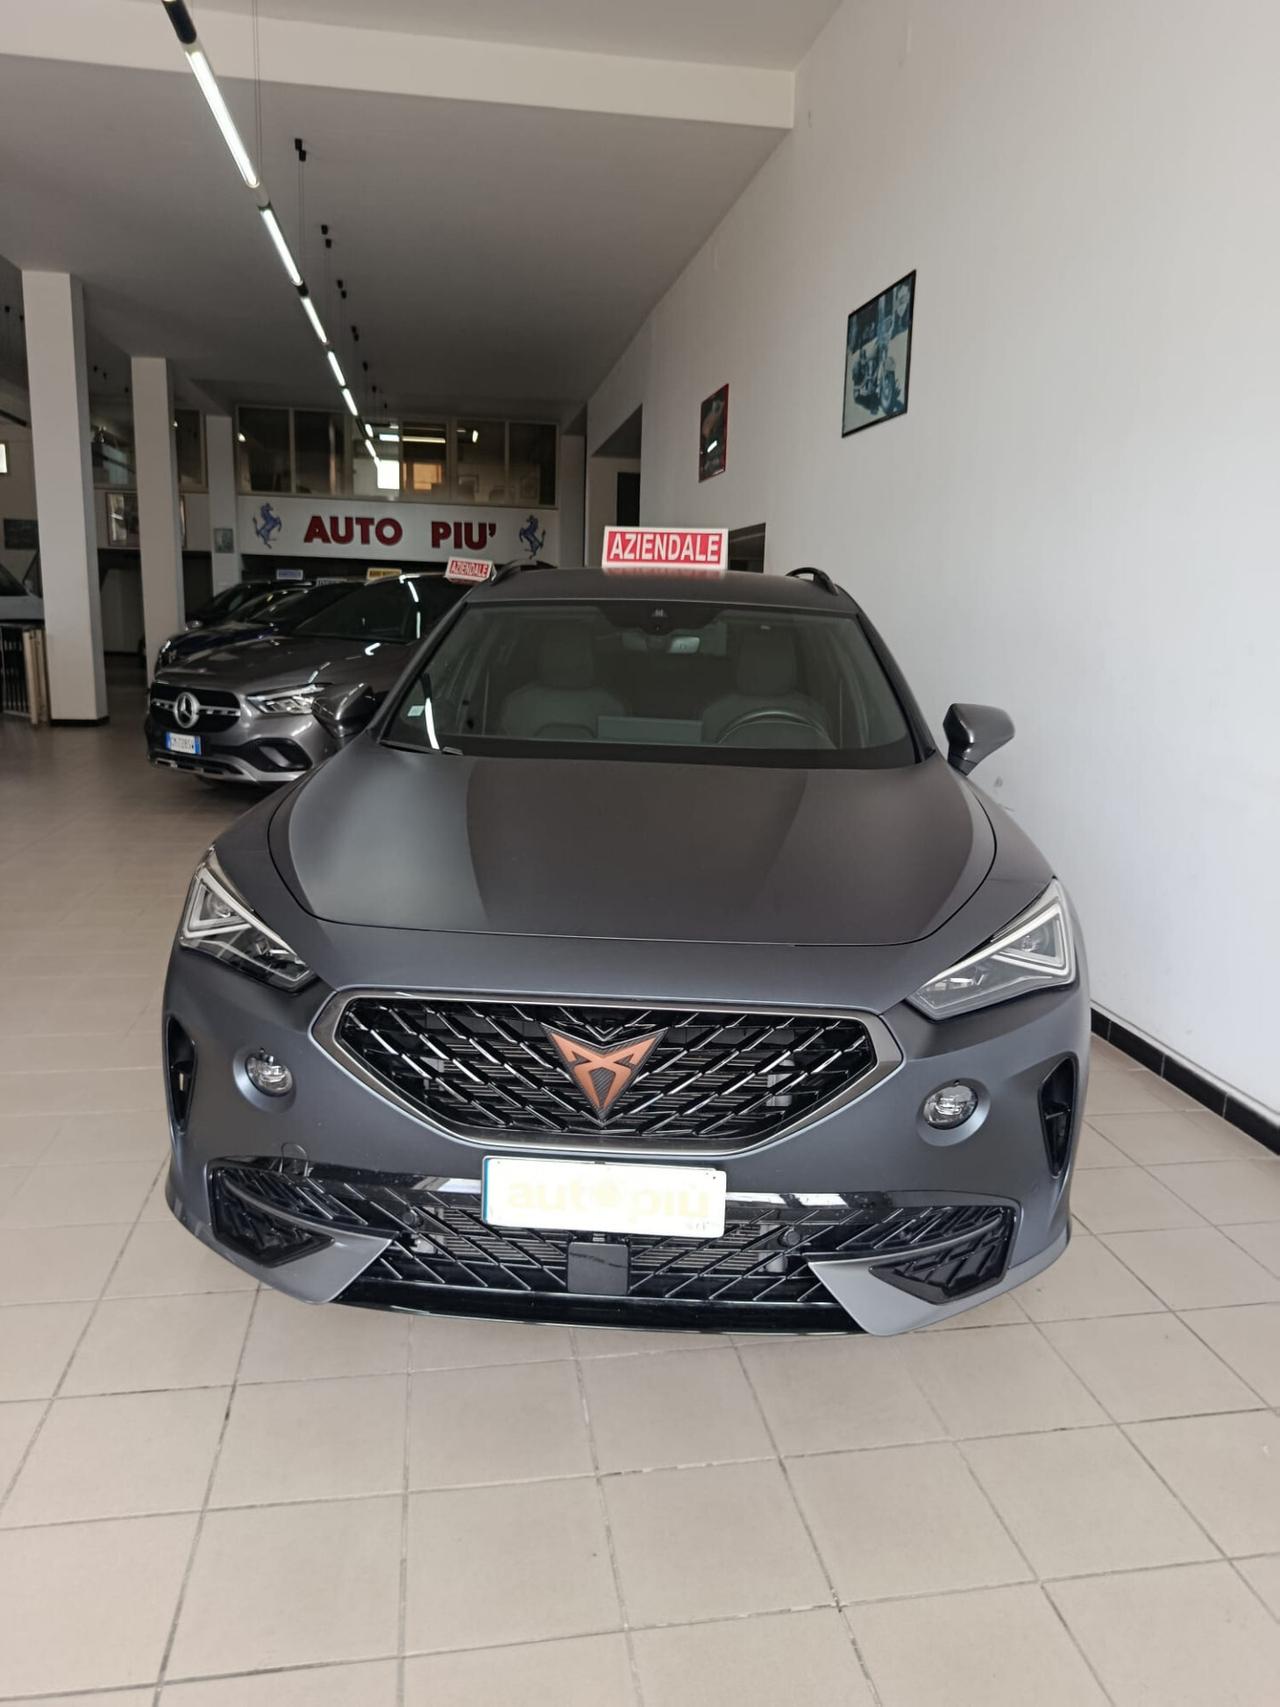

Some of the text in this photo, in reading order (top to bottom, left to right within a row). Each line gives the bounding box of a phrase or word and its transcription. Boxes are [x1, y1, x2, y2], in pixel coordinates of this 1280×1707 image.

[304, 515, 497, 550] AUTO PIU'
[609, 532, 720, 562] AZIENDALE
